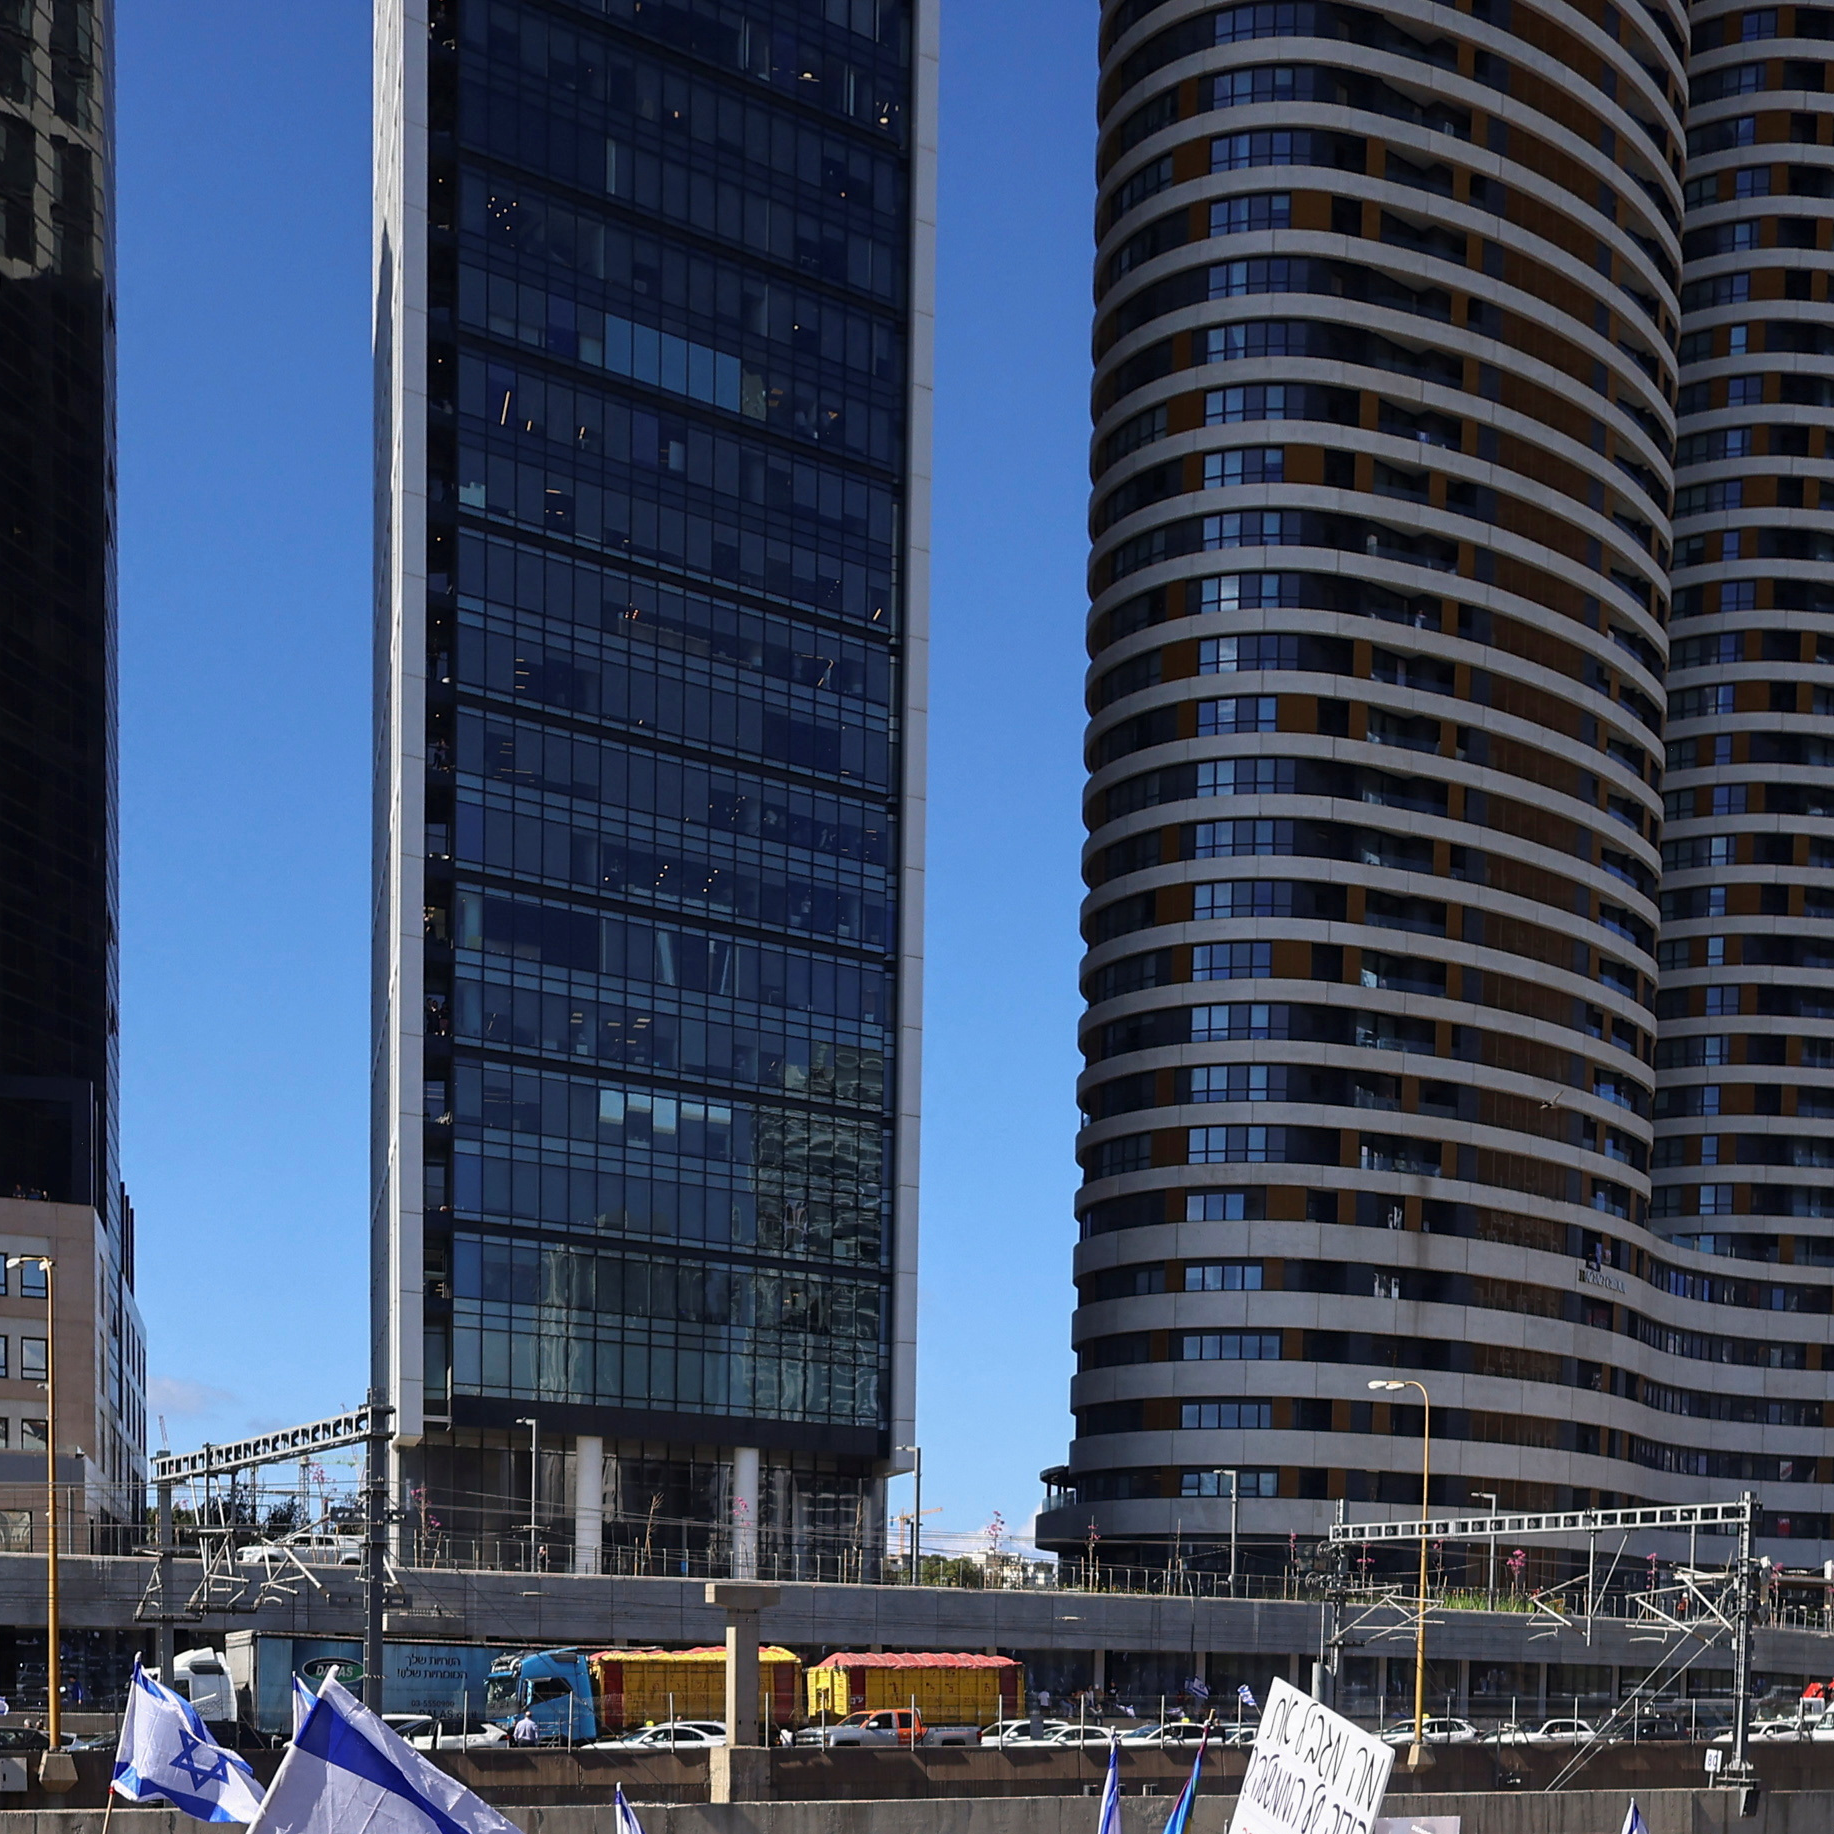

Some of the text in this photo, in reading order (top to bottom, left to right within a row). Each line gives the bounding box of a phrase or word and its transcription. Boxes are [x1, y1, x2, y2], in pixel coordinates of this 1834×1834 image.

[406, 1653, 427, 1667] שלך
[316, 1664, 354, 1678] DAAS
[1266, 1693, 1385, 1812] מה מגביל את
[1708, 1754, 1718, 1767] 80
